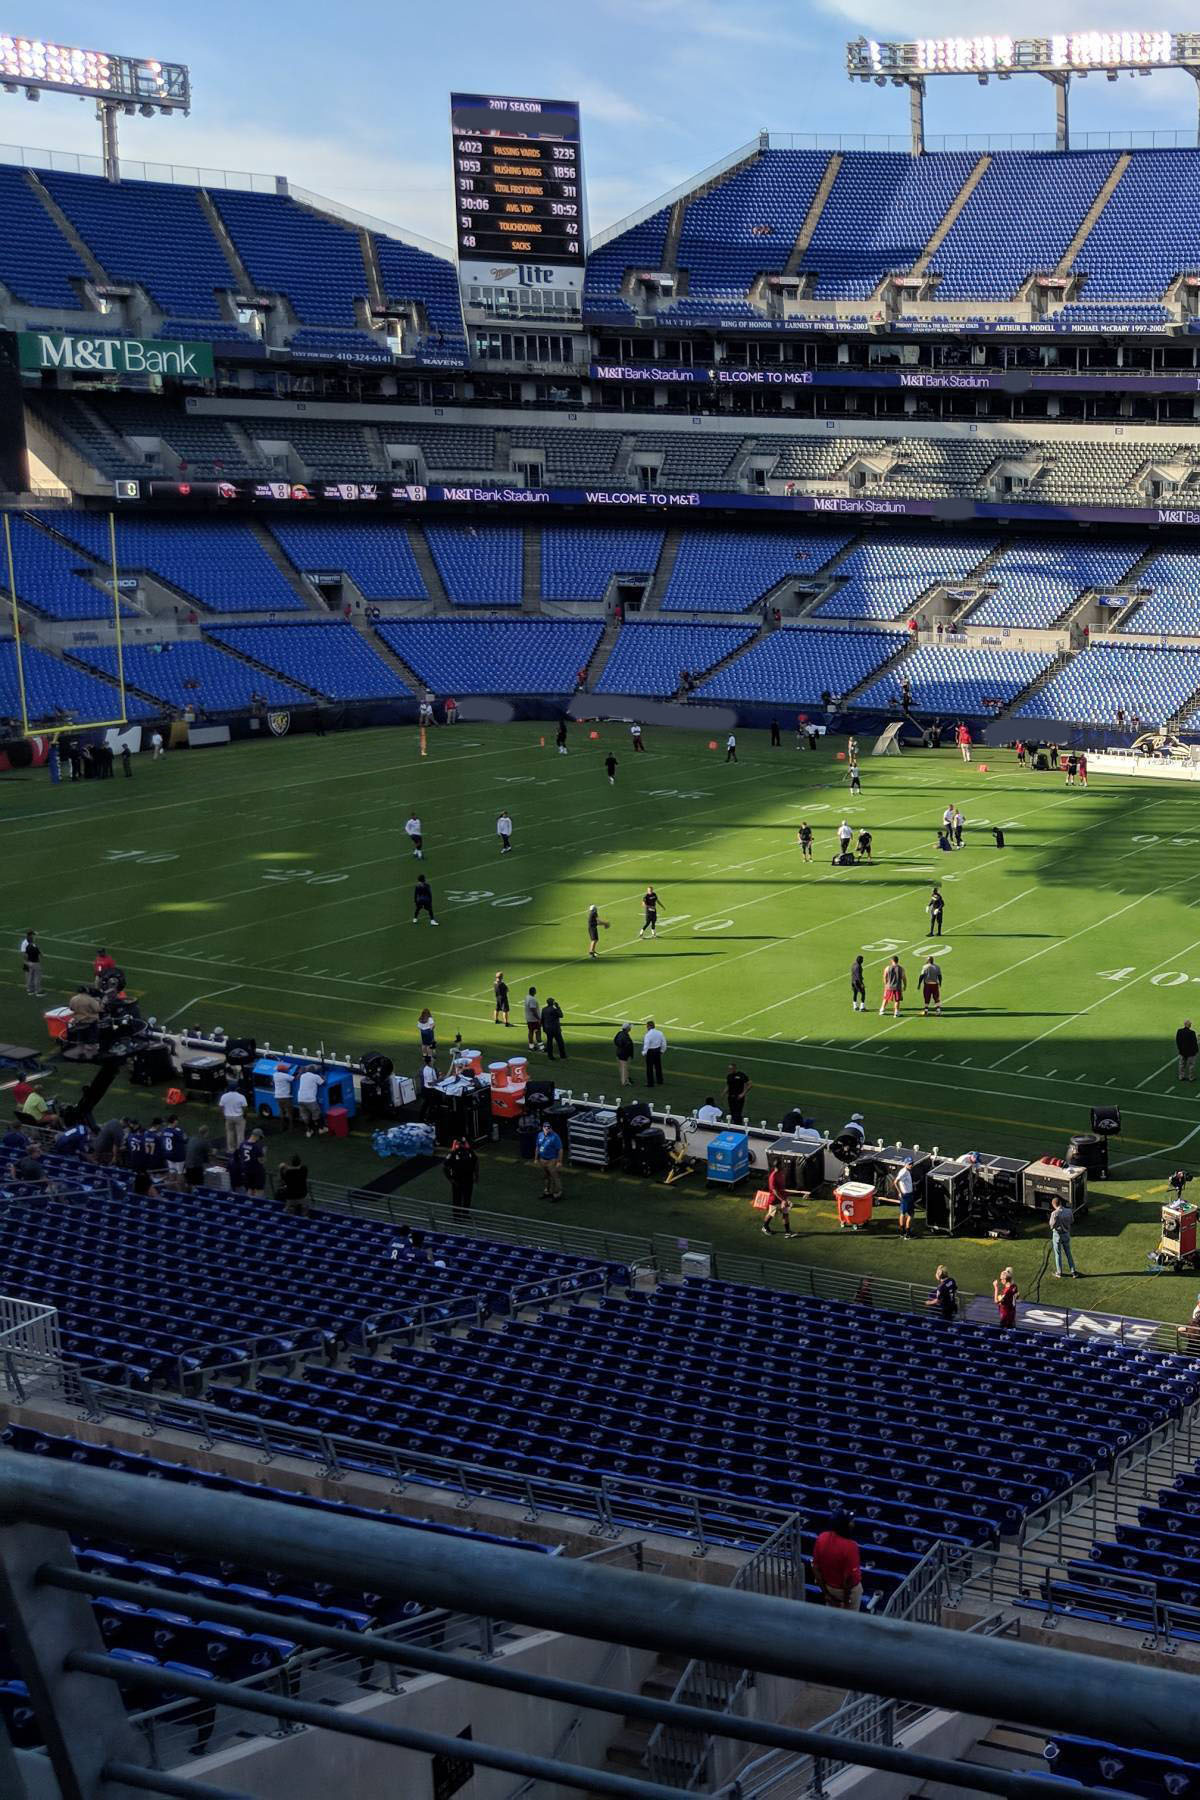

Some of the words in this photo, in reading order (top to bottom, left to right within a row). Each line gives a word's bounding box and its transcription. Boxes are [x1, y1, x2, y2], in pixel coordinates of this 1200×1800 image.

[489, 100, 508, 111] 2017
[509, 102, 542, 113] SEASON
[458, 141, 483, 154] 4023
[494, 146, 521, 157] PASSING
[521, 147, 541, 158] YARDS
[553, 148, 576, 160] 3235
[459, 160, 481, 173] 1953
[494, 165, 522, 176] RUSHING
[522, 166, 543, 177] YARDS
[553, 166, 576, 179] 1856
[460, 179, 474, 191] 311
[494, 183, 510, 193] TOTAL
[510, 184, 525, 194] FIRST
[525, 185, 544, 196] DOWNS
[563, 185, 577, 197] 311
[460, 198, 489, 211] 30:06
[520, 204, 534, 214] TOP
[551, 204, 578, 216] 30:52
[462, 216, 472, 228] 51
[499, 221, 543, 233] TOUCHDOWNS
[566, 223, 578, 234] 42
[462, 235, 476, 248] 48
[511, 241, 532, 251] SACKS
[568, 242, 579, 254] 41
[517, 264, 554, 287] Lite
[720, 320, 738, 328] RING
[748, 321, 773, 329] HONOR
[785, 322, 813, 330] EARNEST
[38, 335, 120, 370] M&T
[124, 341, 198, 374] Bank
[336, 353, 392, 363] 410-324-6141
[422, 358, 464, 366] RAVENS
[597, 367, 625, 379] M&T
[624, 368, 651, 380] Bank
[651, 369, 694, 381] Stadium
[763, 372, 783, 384] TO
[900, 374, 926, 386] M&T
[926, 374, 949, 387] Bank
[949, 376, 990, 388] Stadium
[443, 488, 474, 500] M&T
[474, 489, 501, 501] Bank
[503, 490, 549, 502] Stadium
[586, 493, 647, 504] WELCOME
[650, 494, 666, 505] TO
[814, 499, 840, 511] M&T
[840, 500, 865, 512] Bank
[866, 501, 905, 513] Stadium
[1158, 510, 1186, 522] M&T
[105, 848, 181, 864] 10
[260, 868, 350, 884] 20
[443, 887, 534, 908] 30
[860, 937, 953, 959] 50
[1096, 965, 1190, 988] 40
[165, 1137, 173, 1151] 8
[243, 1150, 251, 1162] 5
